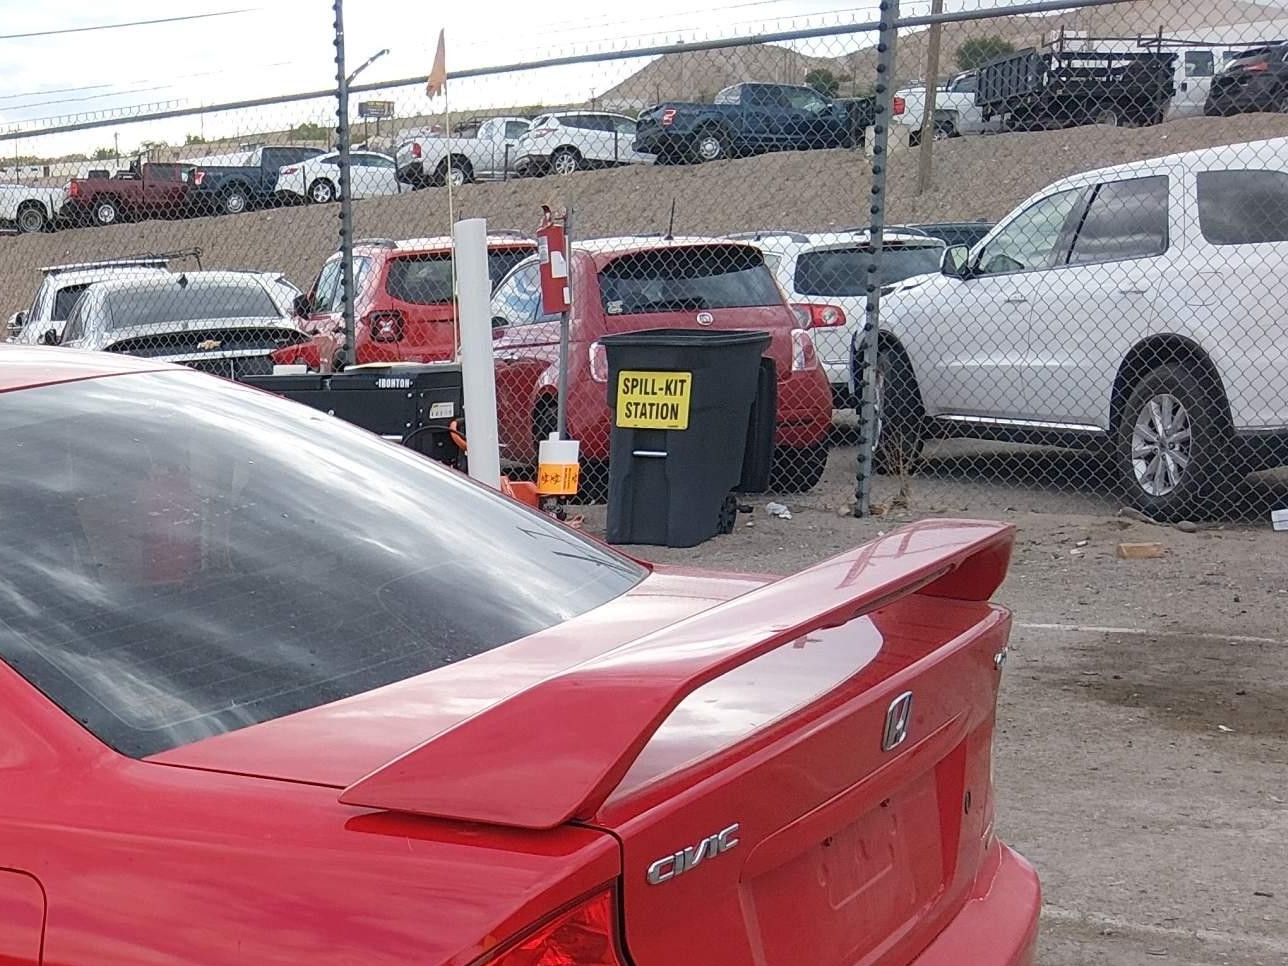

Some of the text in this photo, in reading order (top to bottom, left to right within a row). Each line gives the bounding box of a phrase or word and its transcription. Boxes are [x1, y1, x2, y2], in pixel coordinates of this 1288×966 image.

[378, 378, 410, 389] IRONTON
[622, 377, 687, 397] SPILL-KIT
[624, 401, 679, 420] STATION
[647, 823, 739, 885] CIVIC
